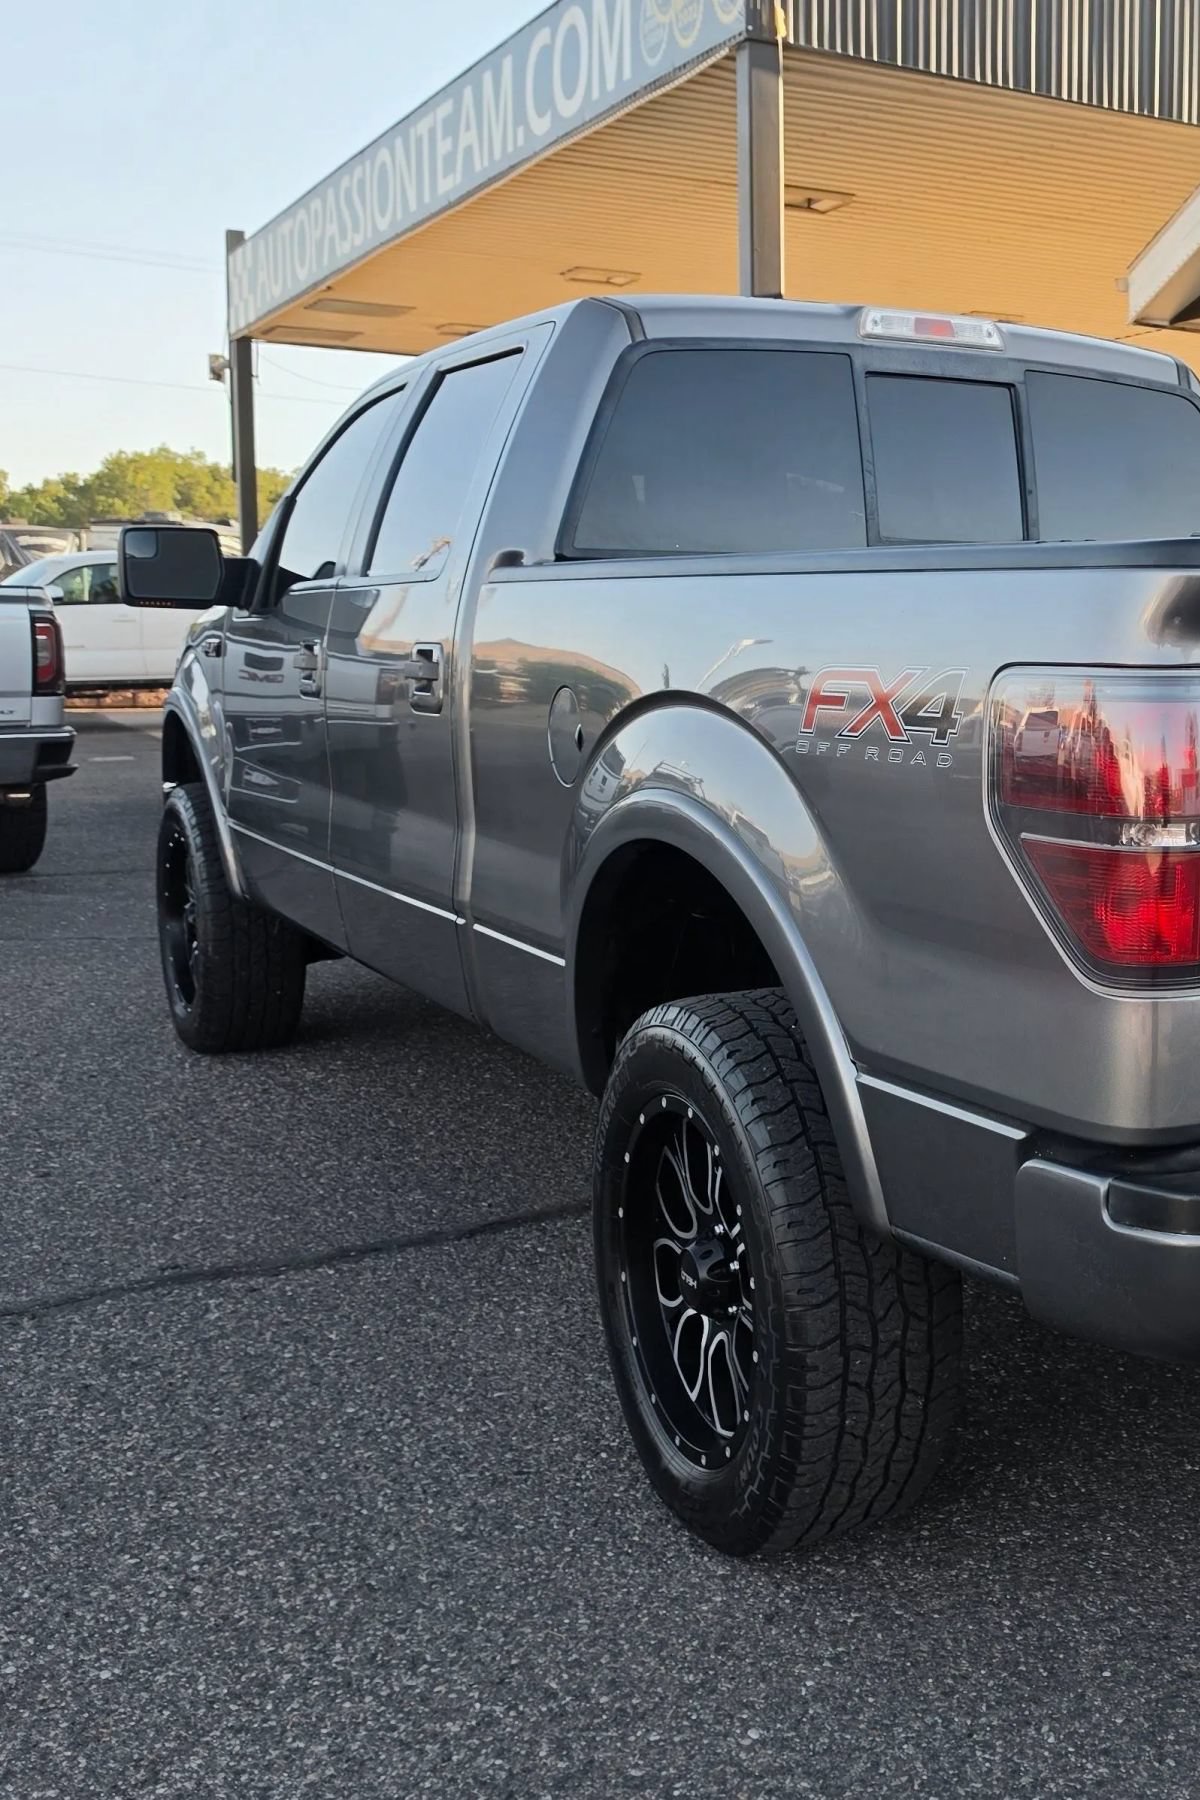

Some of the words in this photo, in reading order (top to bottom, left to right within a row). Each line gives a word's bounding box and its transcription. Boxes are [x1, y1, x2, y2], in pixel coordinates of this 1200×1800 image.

[256, 0, 633, 308] AUTOPASSIONTEAM.COM
[798, 663, 970, 748] FX4
[795, 740, 851, 757] OFF
[864, 746, 953, 768] ROAD
